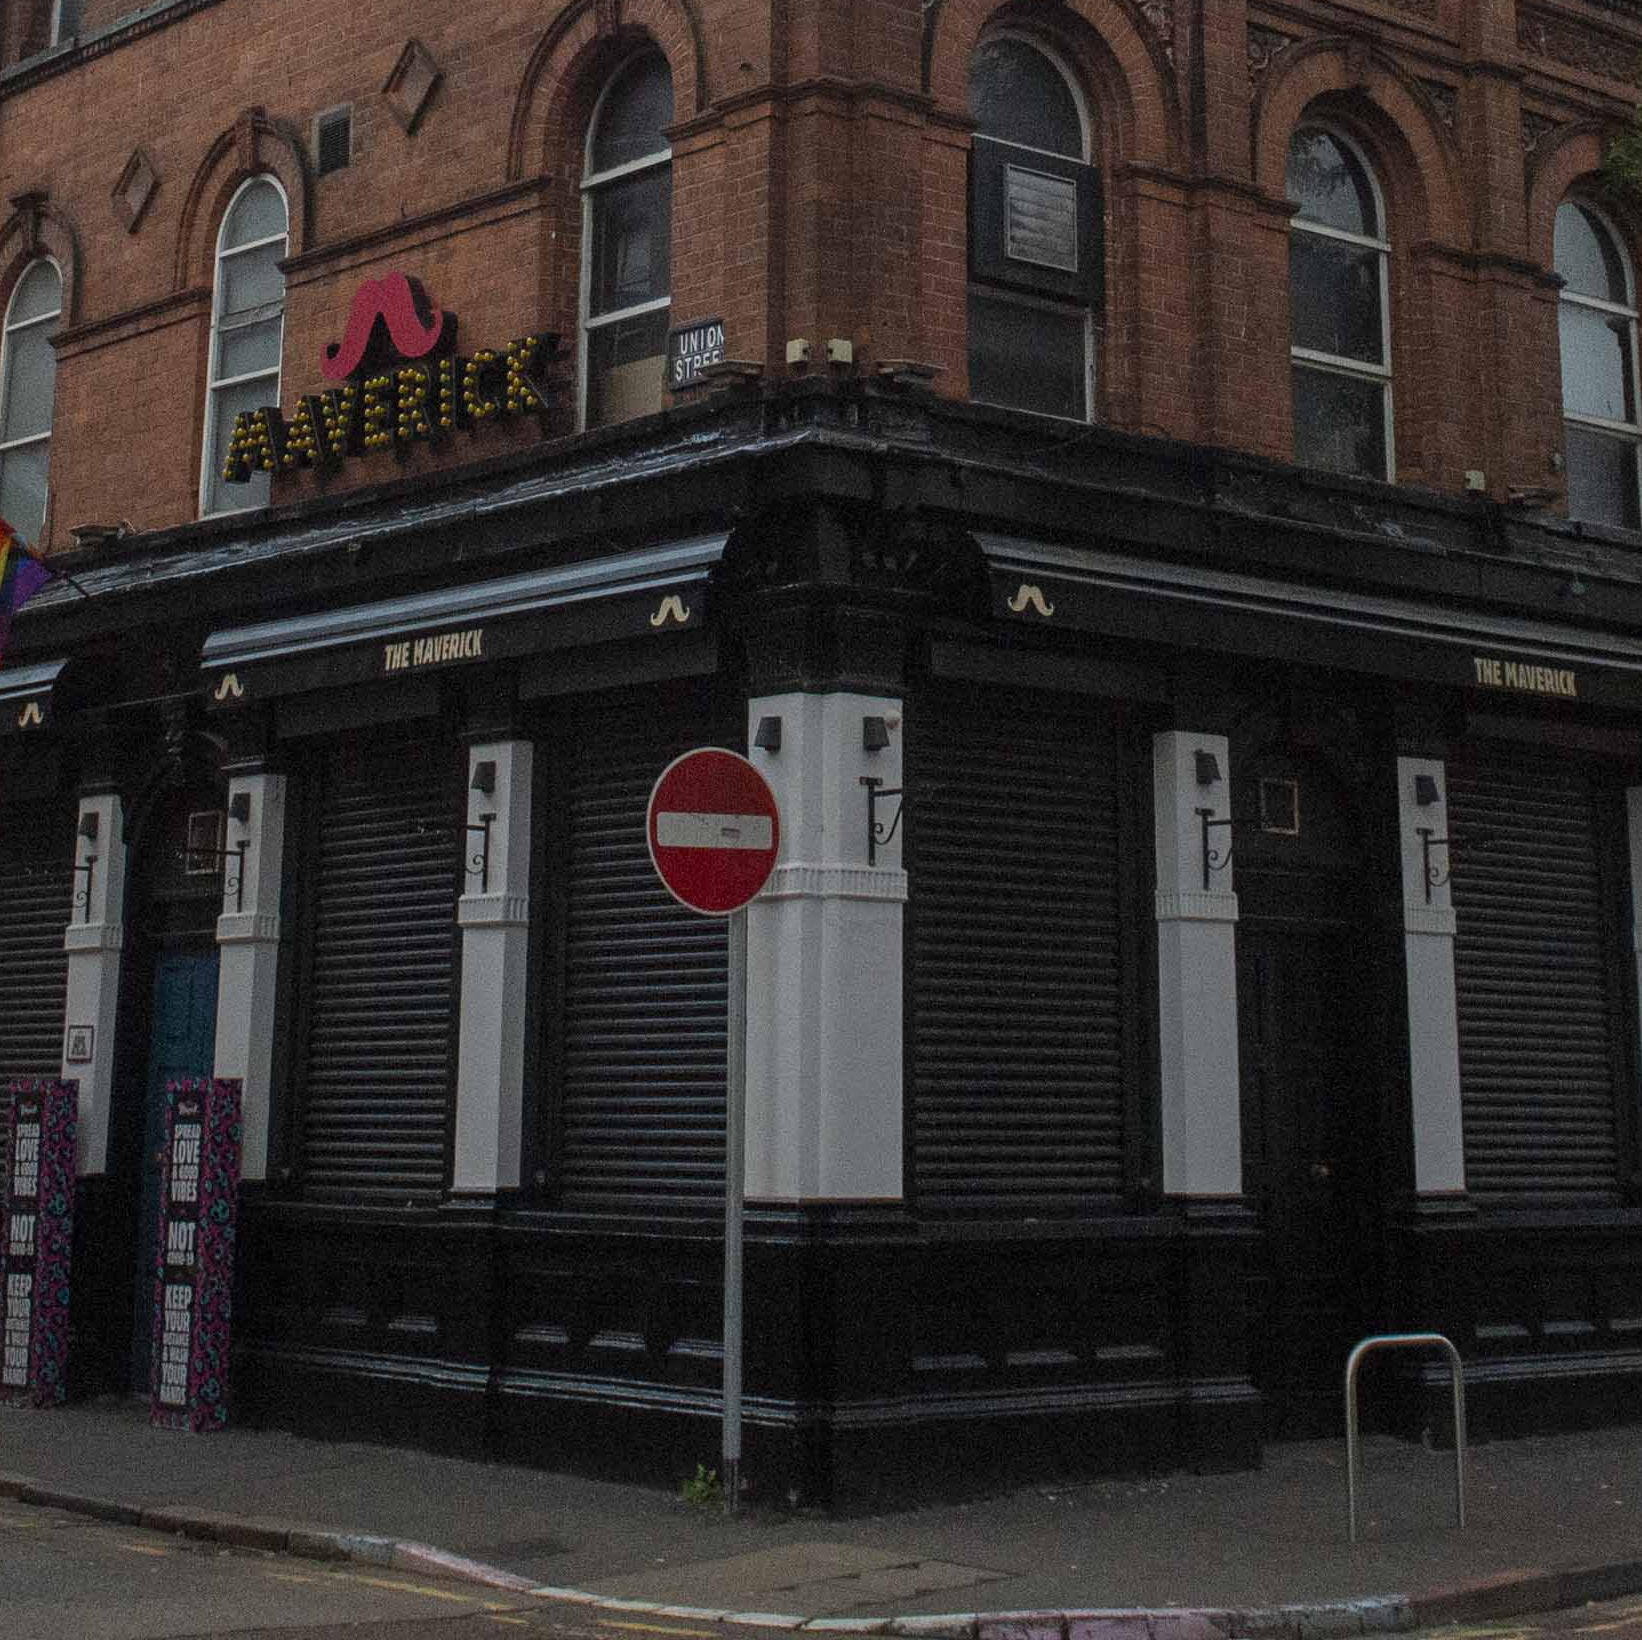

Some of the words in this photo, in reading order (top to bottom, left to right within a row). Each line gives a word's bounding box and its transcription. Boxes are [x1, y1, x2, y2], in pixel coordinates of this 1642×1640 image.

[680, 325, 724, 355] UNION
[674, 350, 724, 382] STREE
[221, 334, 552, 482] MAVERICK
[384, 642, 410, 671] THE
[413, 628, 484, 666] MAVERICK
[1474, 657, 1503, 686] THE
[1505, 661, 1577, 697] MAVERICK
[15, 1139, 40, 1161] LOVE
[173, 1140, 200, 1164] LOVE
[171, 1181, 198, 1202] VIBES
[10, 1215, 36, 1241] NOT
[168, 1221, 196, 1251] NOT
[7, 1273, 33, 1298] KEEP
[164, 1285, 192, 1310] KEEP
[164, 1311, 191, 1333] YOUR
[161, 1363, 188, 1385] YOUR
